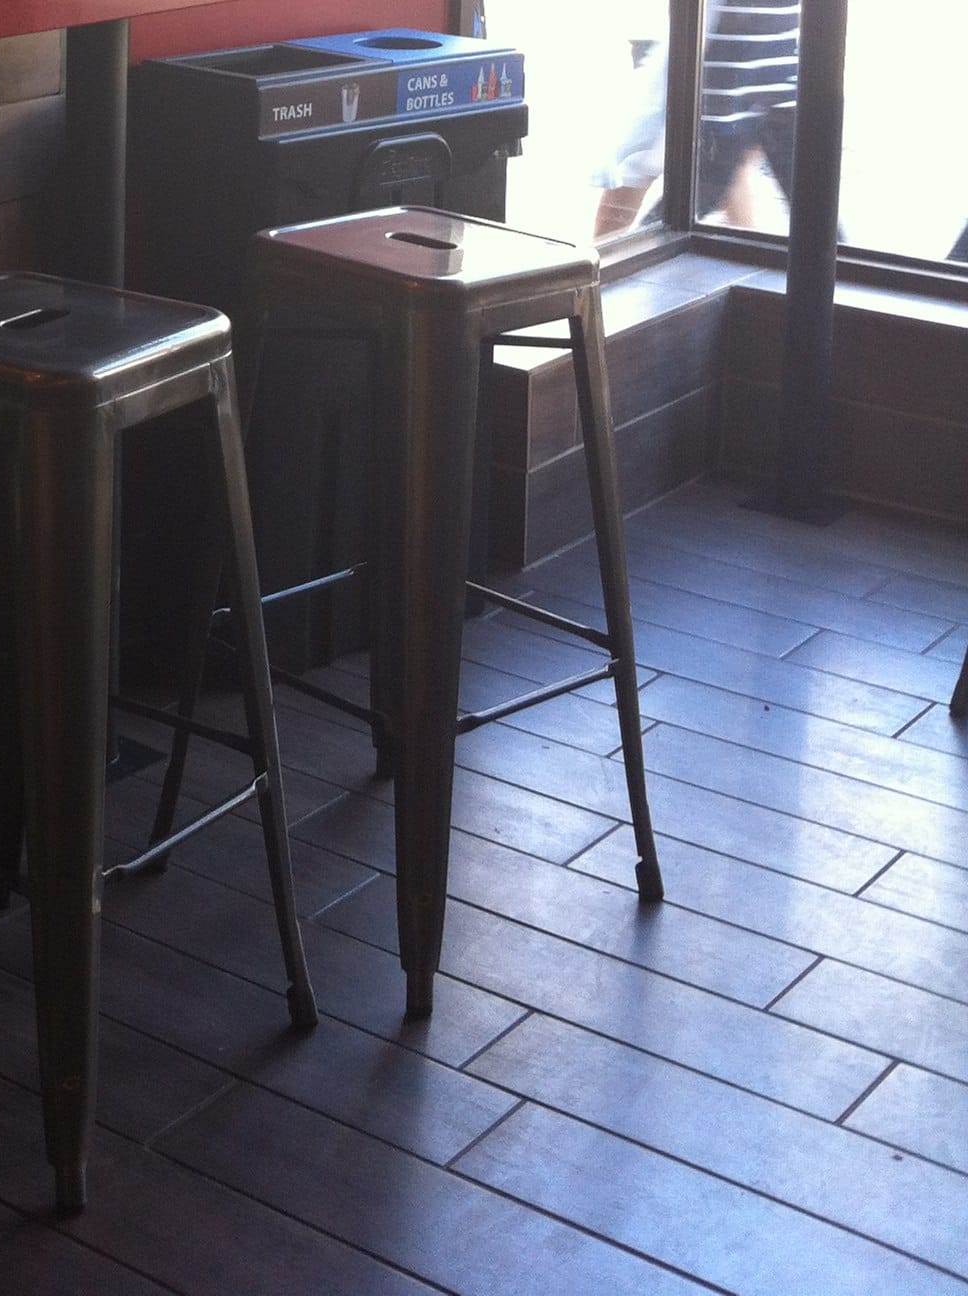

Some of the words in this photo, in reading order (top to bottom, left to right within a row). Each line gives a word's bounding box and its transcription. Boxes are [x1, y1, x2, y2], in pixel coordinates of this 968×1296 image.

[407, 74, 438, 92] CANS
[439, 74, 448, 88] &
[406, 91, 455, 112] BOTTLES
[272, 103, 313, 122] TRASH
